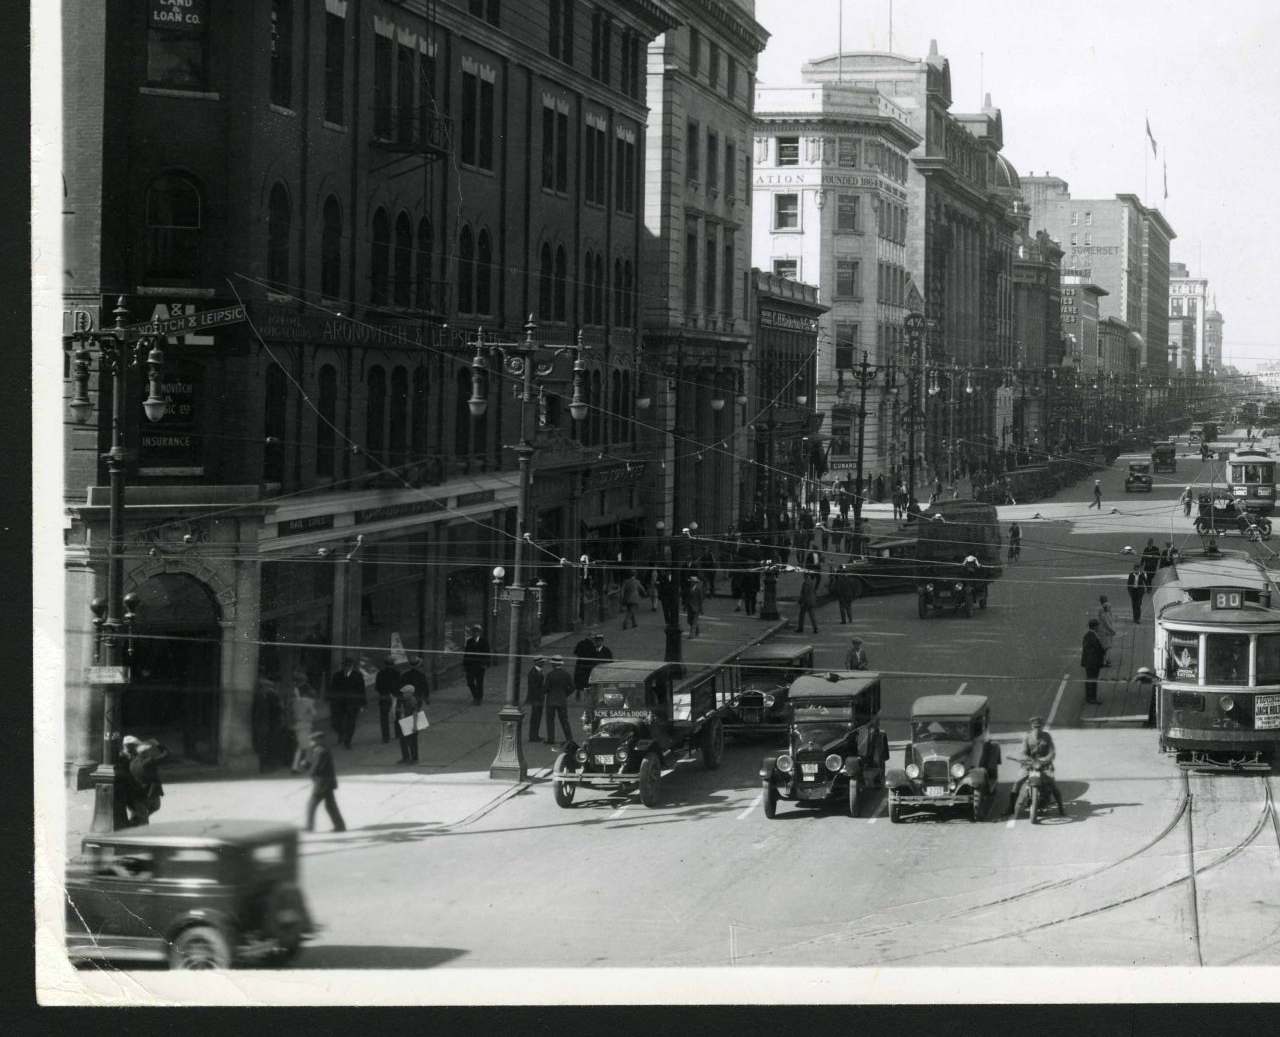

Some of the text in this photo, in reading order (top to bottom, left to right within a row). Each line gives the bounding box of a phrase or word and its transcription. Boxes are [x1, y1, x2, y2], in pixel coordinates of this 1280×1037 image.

[154, 11, 182, 22] LOAN
[756, 175, 804, 184] ATION
[822, 176, 858, 186] FOUNDED
[201, 307, 243, 326] LEIPSIC
[323, 321, 406, 345] ARONOVITCH
[142, 435, 191, 447] INSURANCE
[1256, 706, 1269, 716] JACK
